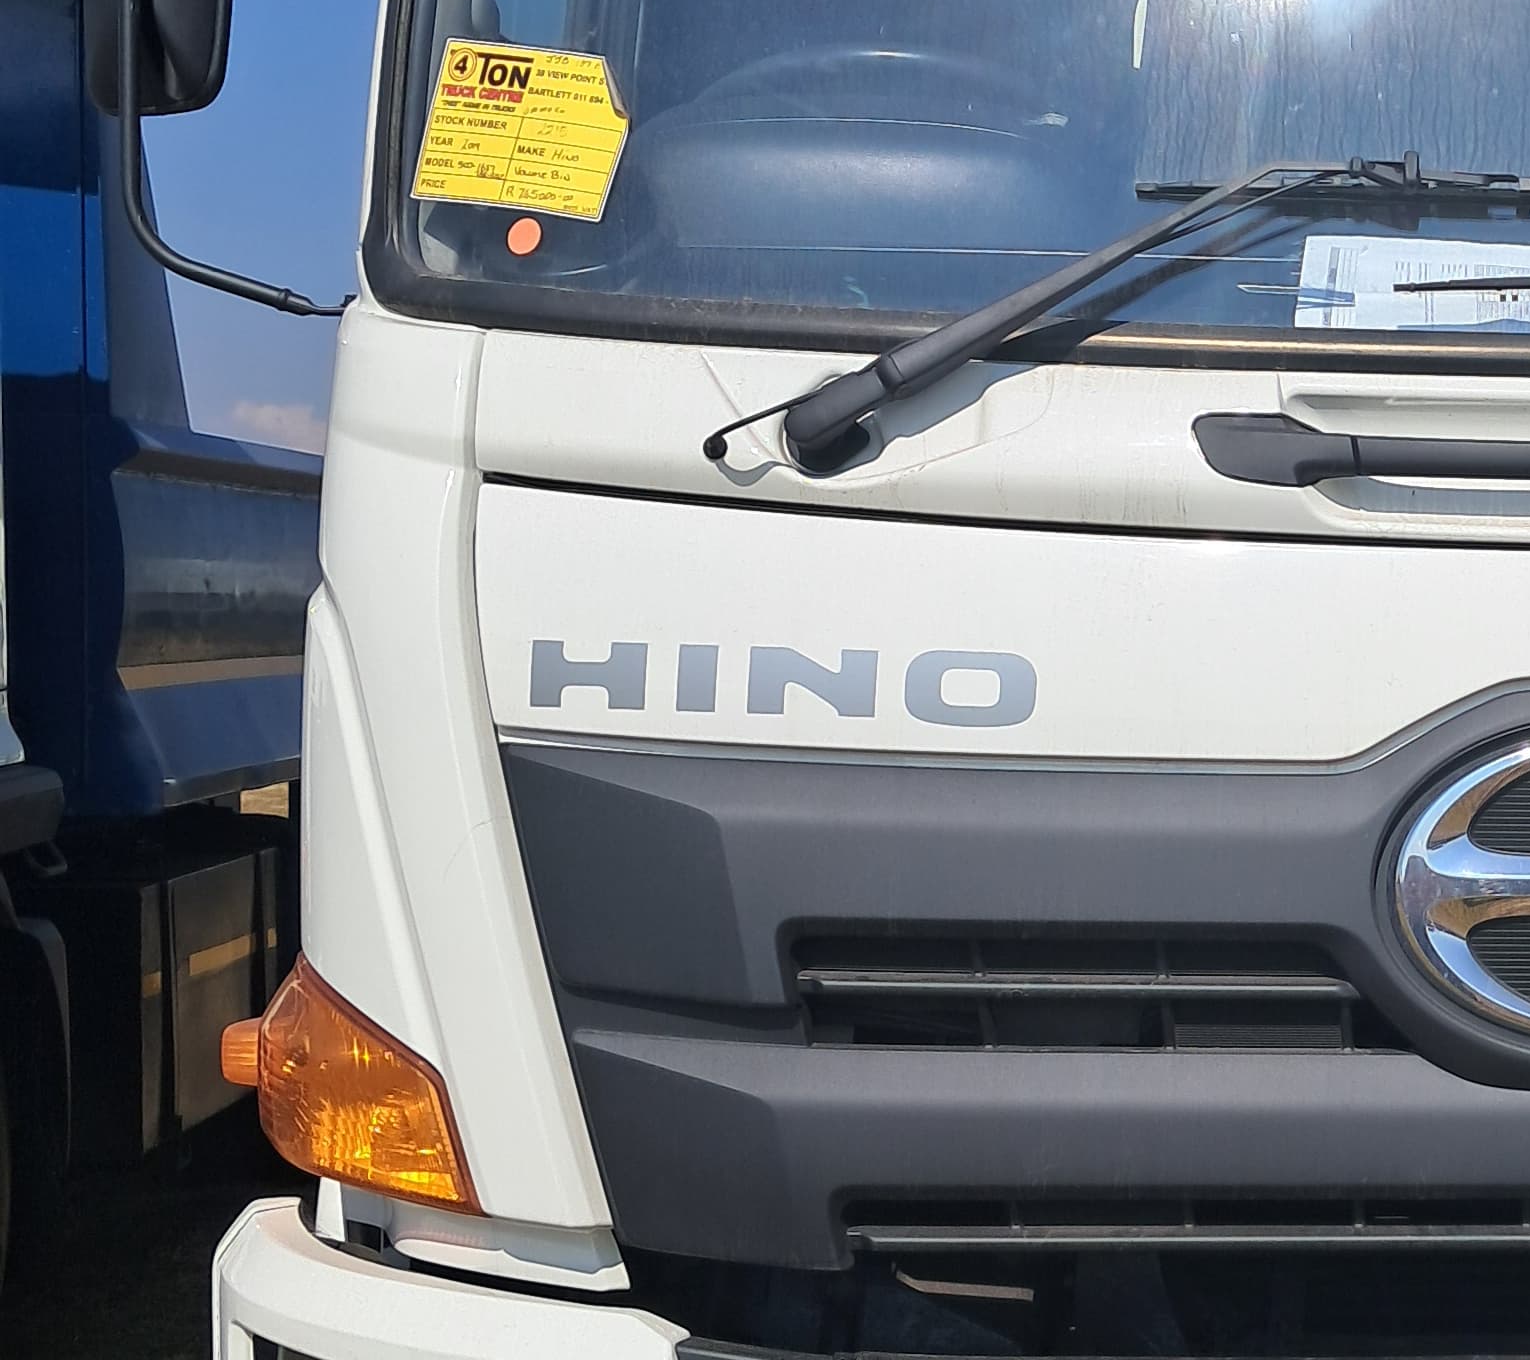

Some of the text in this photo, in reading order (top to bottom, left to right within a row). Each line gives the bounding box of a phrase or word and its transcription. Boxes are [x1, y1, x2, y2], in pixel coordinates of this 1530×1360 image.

[453, 52, 534, 90] 4 TON
[548, 69, 570, 81] VIEW
[570, 73, 598, 84] POINT
[527, 86, 573, 99] BARTLETT
[434, 114, 508, 130] STOCK NUMBER
[430, 135, 454, 147] YEAR
[517, 145, 546, 157] MAKE
[425, 157, 455, 169] MODEL
[420, 178, 447, 189] PRICE
[529, 639, 1038, 729] HINO
